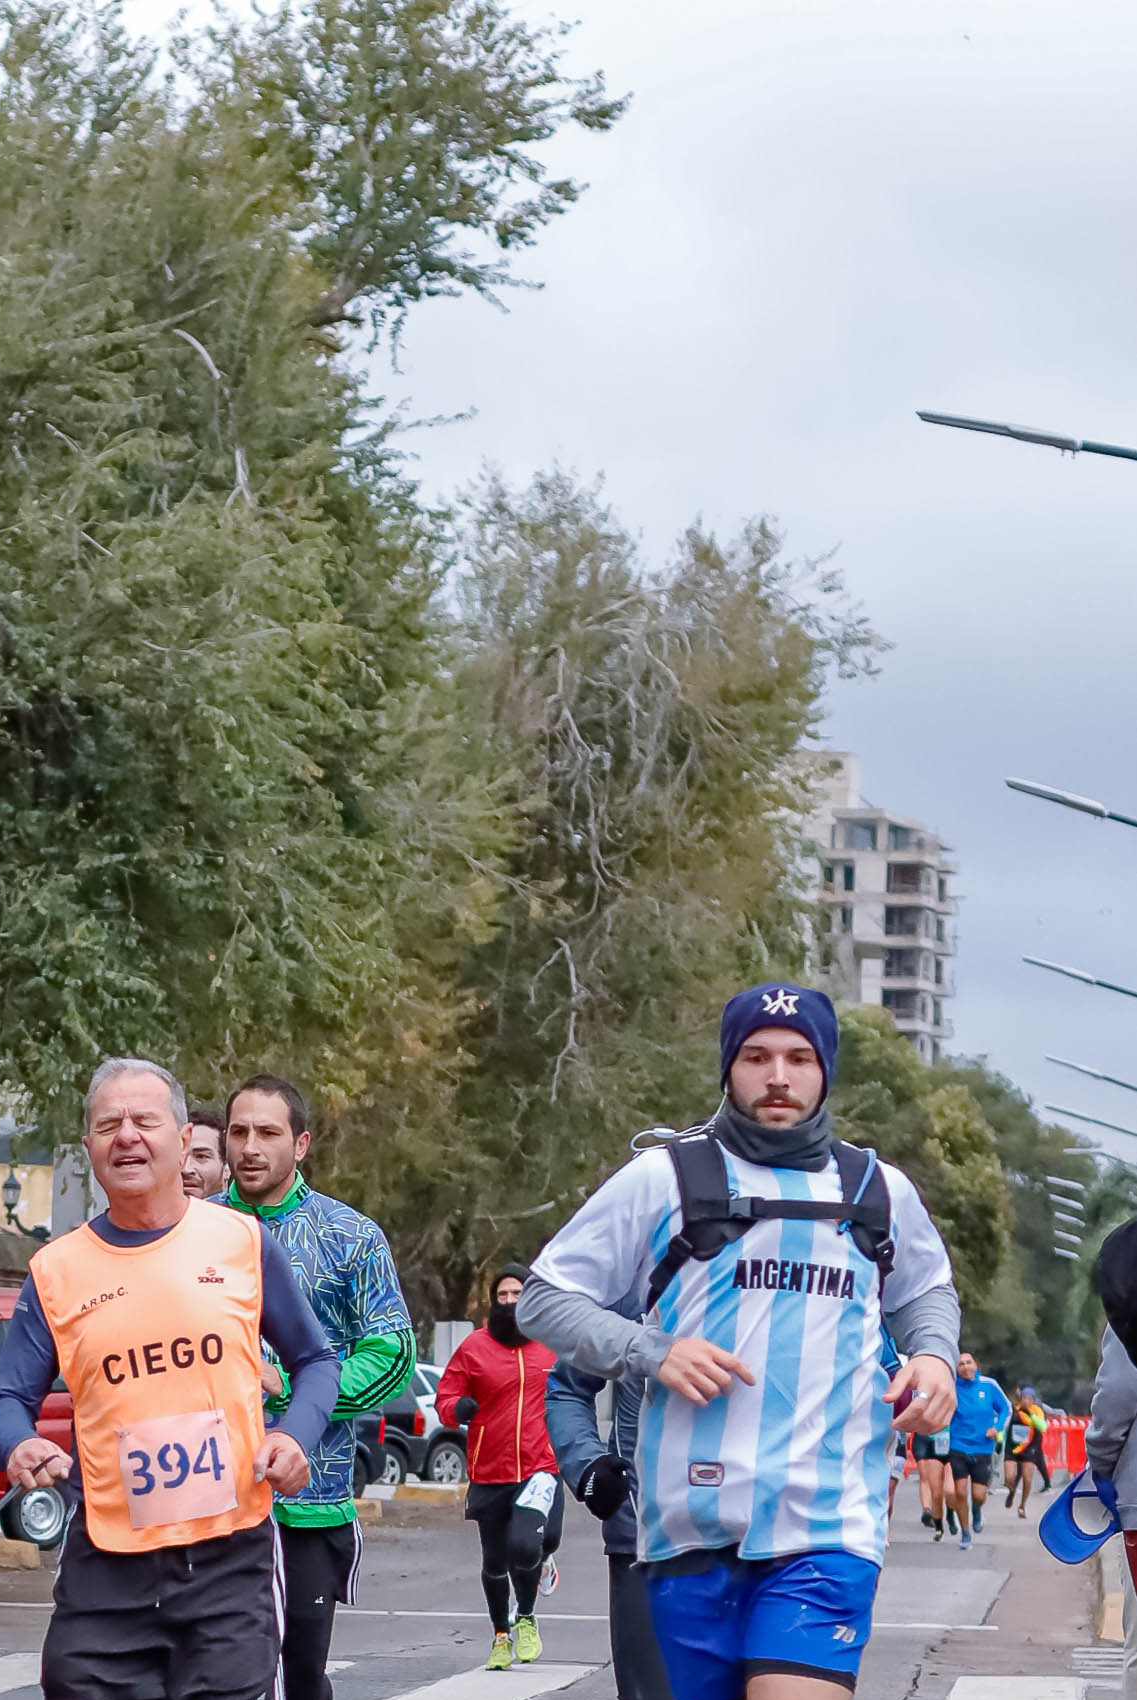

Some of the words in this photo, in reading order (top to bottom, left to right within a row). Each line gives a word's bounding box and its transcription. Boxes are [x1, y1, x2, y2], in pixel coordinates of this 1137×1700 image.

[732, 1258, 855, 1300] ARGENTINA
[102, 1333, 223, 1385] CIEGO
[127, 1436, 225, 1496] 394
